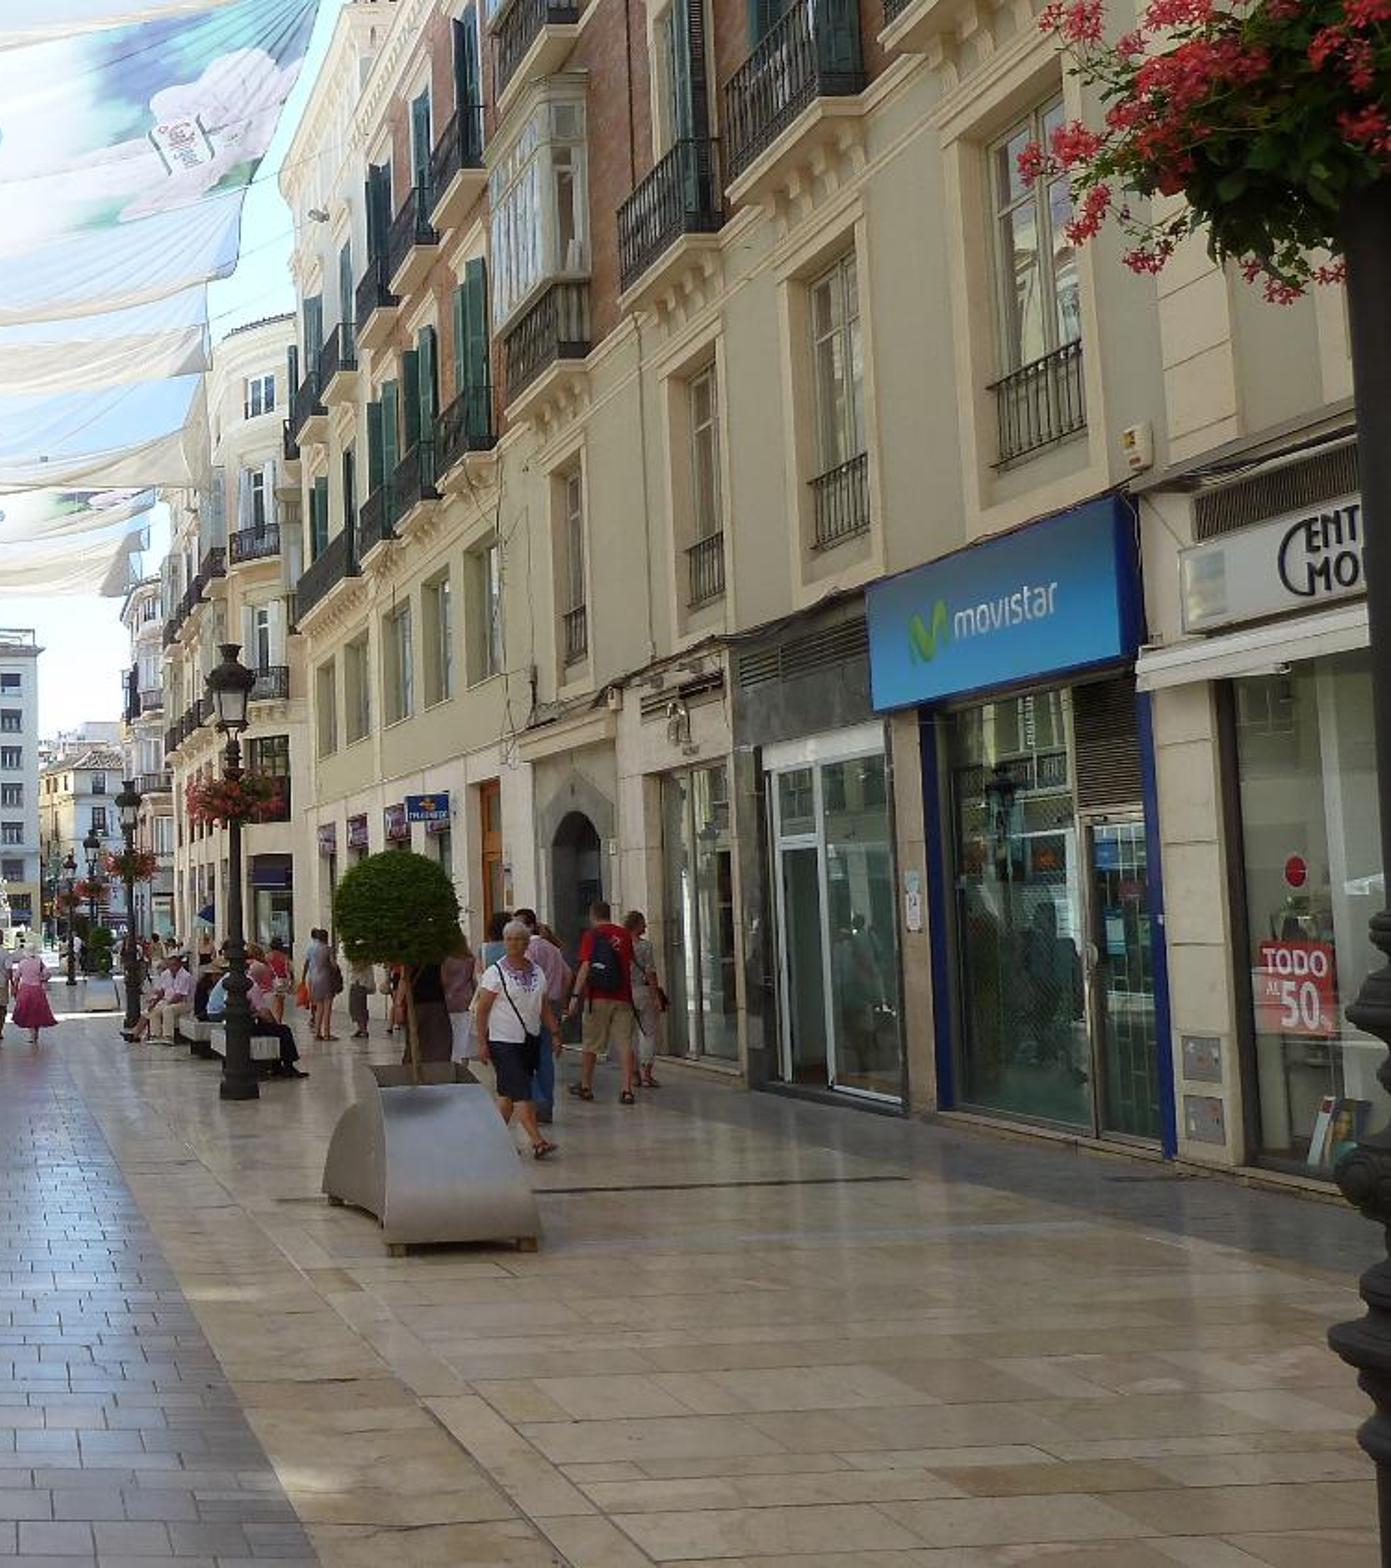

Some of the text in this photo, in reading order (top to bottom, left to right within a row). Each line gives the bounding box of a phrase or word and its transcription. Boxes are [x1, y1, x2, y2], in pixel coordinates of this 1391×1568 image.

[1306, 551, 1364, 596] MO
[953, 581, 1058, 641] movistar
[1262, 947, 1329, 978] TODO
